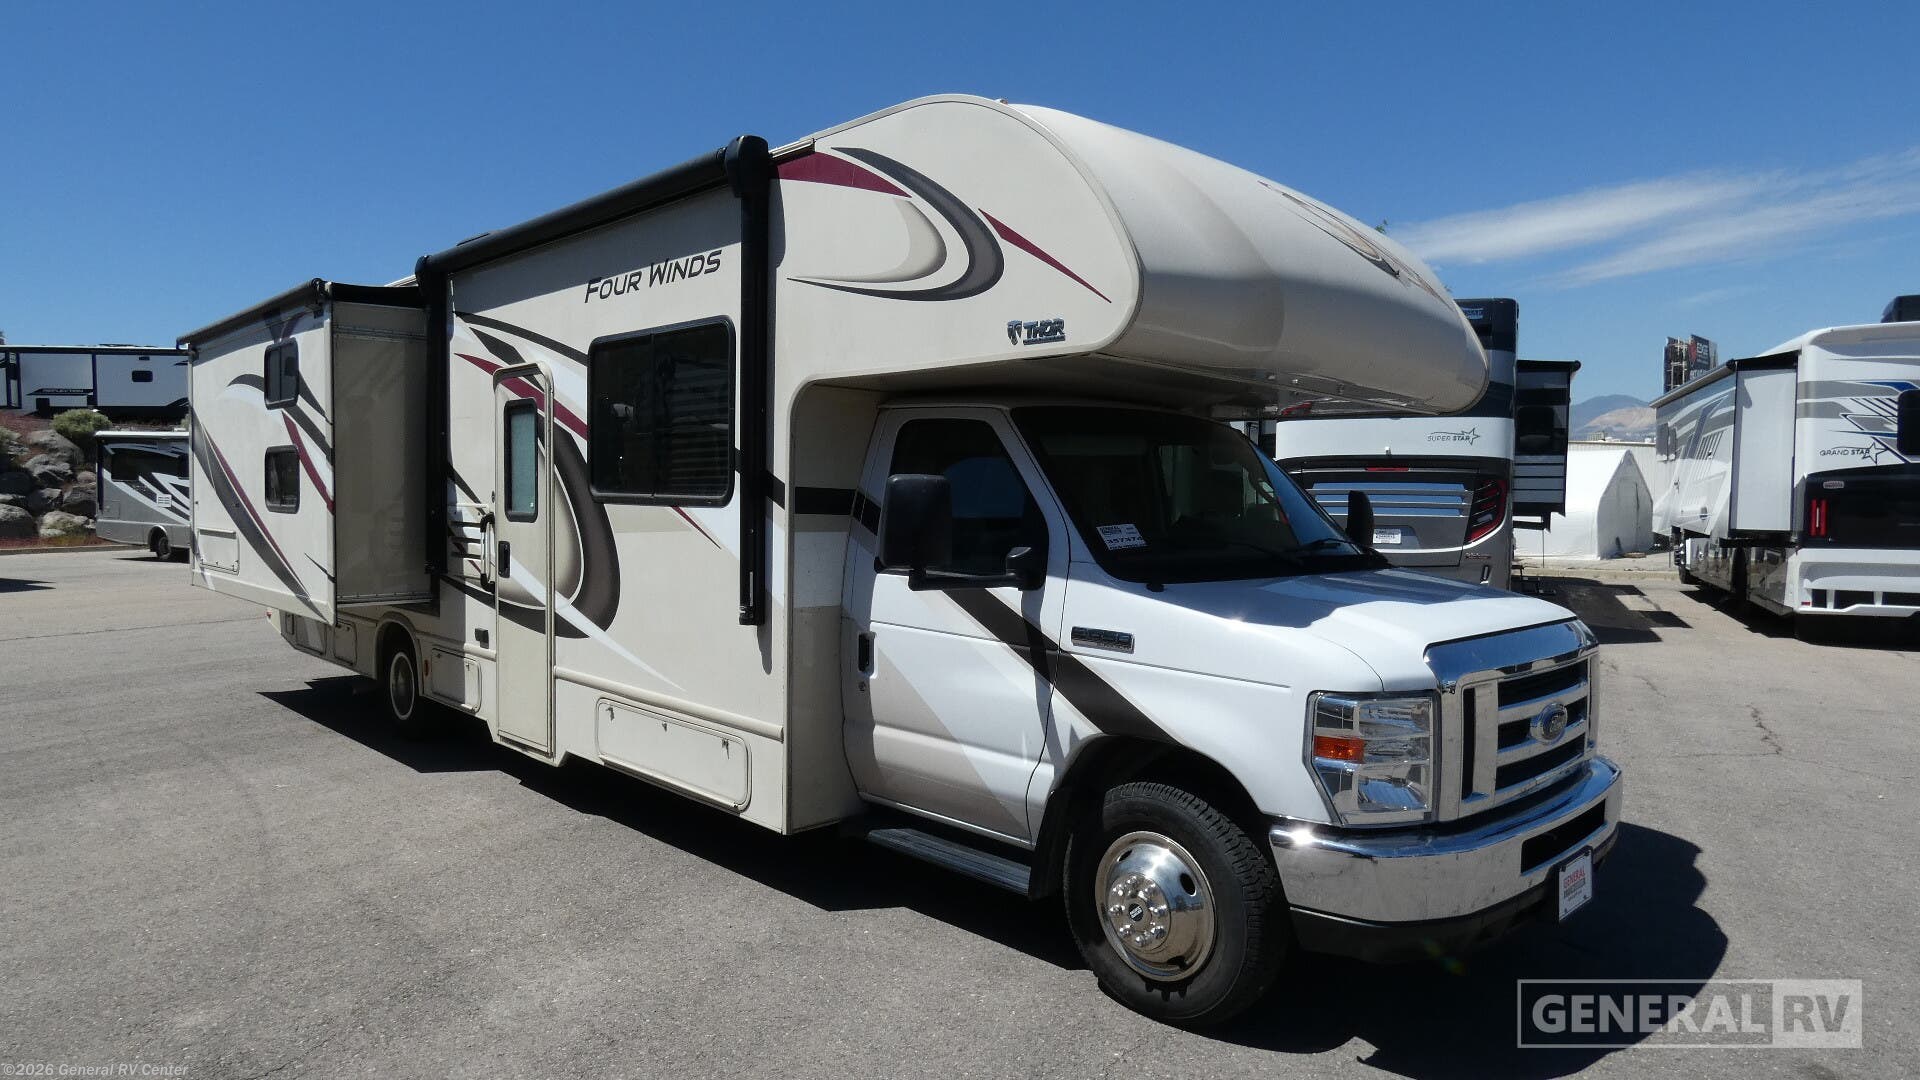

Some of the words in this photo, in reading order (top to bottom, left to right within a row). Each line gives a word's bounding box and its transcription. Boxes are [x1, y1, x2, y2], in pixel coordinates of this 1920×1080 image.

[584, 270, 642, 304] FOUR
[649, 249, 722, 288] WINDS
[1023, 319, 1065, 339] THOR
